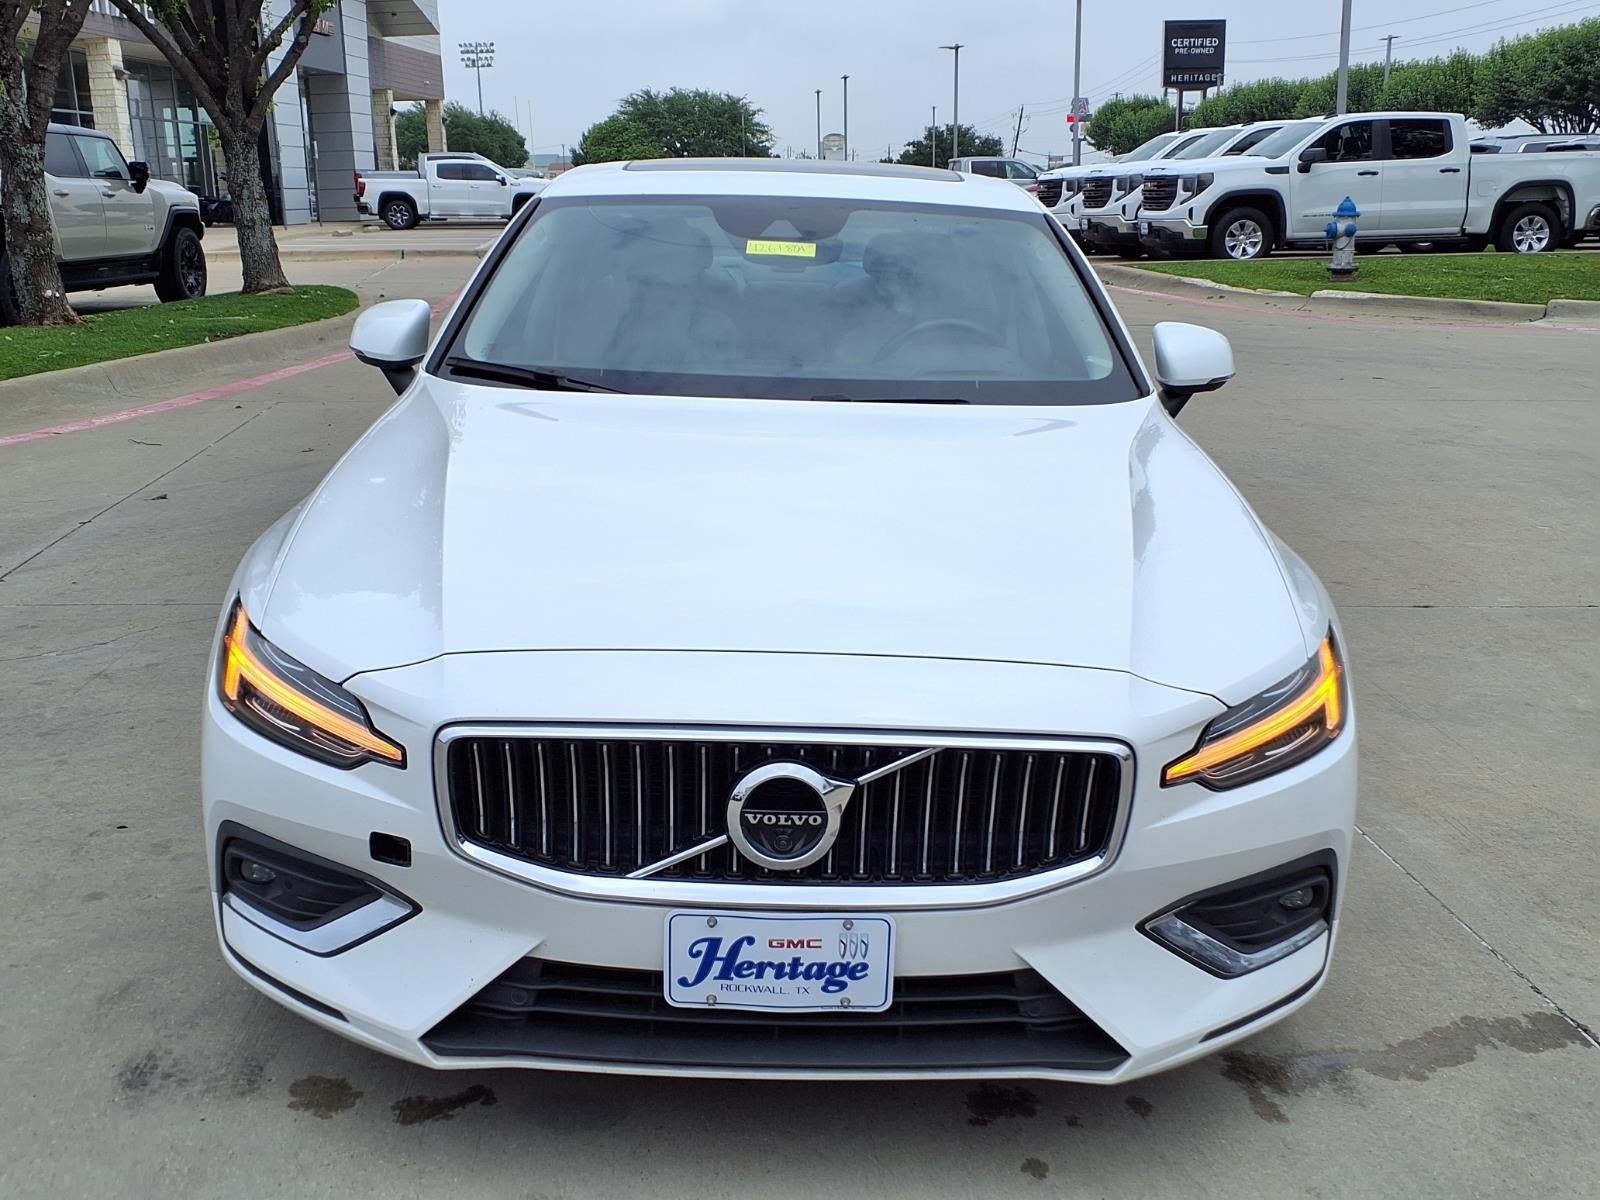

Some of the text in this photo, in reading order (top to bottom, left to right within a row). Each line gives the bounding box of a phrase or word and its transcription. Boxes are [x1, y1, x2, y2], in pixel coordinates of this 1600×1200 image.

[1171, 37, 1219, 47] CERTIFIED
[1170, 73, 1217, 82] HERITAGE
[745, 813, 822, 826] VOLVO
[768, 938, 822, 949] GMC
[677, 935, 869, 994] Heritage
[795, 986, 810, 995] TX
